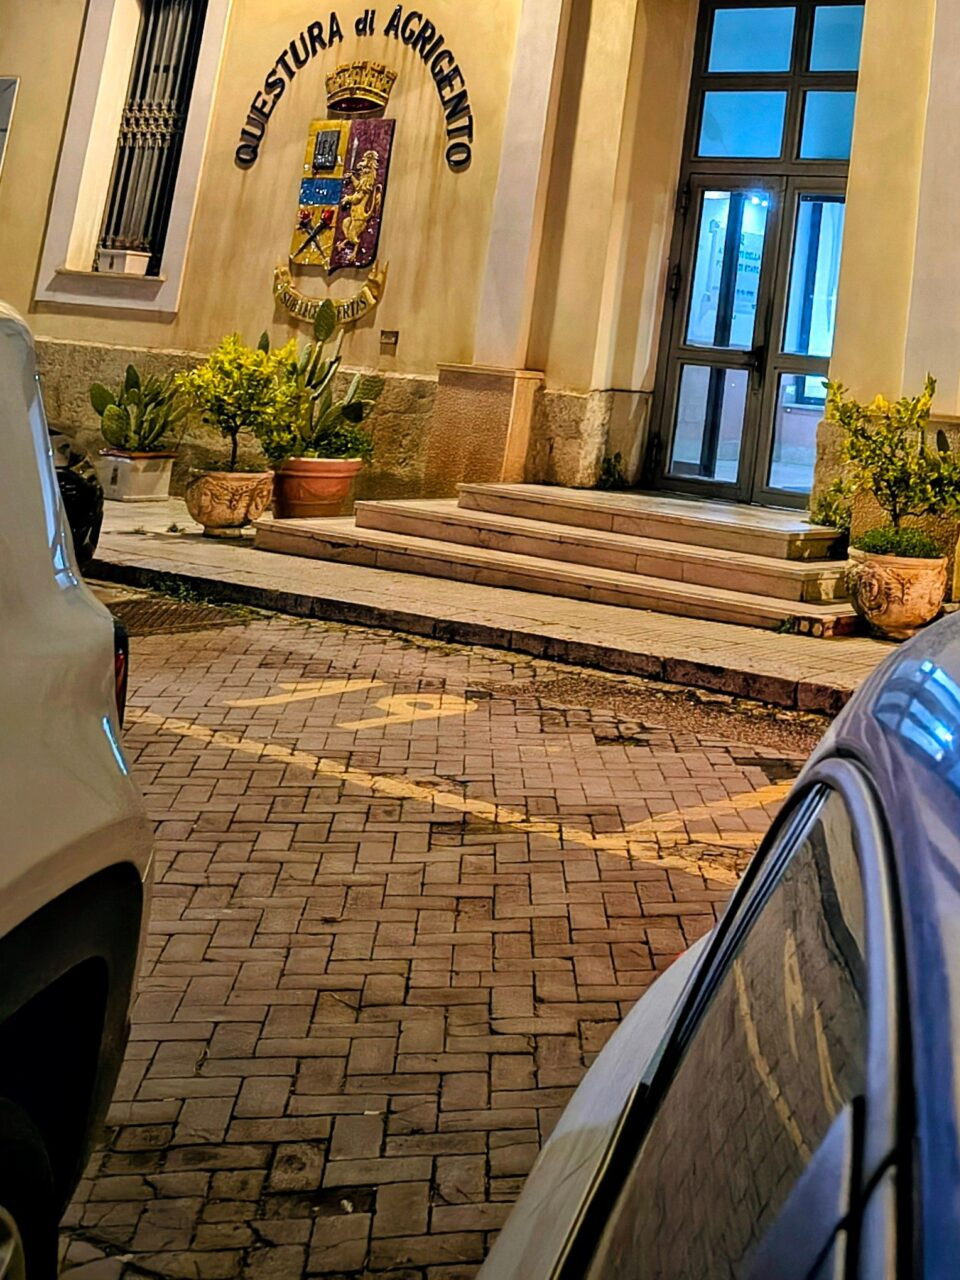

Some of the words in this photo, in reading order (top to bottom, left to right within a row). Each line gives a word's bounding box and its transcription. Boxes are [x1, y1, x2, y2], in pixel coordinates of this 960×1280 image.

[235, 11, 342, 169] QUESTURA
[383, 4, 473, 172] AGRIGENTO
[281, 291, 298, 312] SUB
[333, 297, 367, 321] ERTAS
